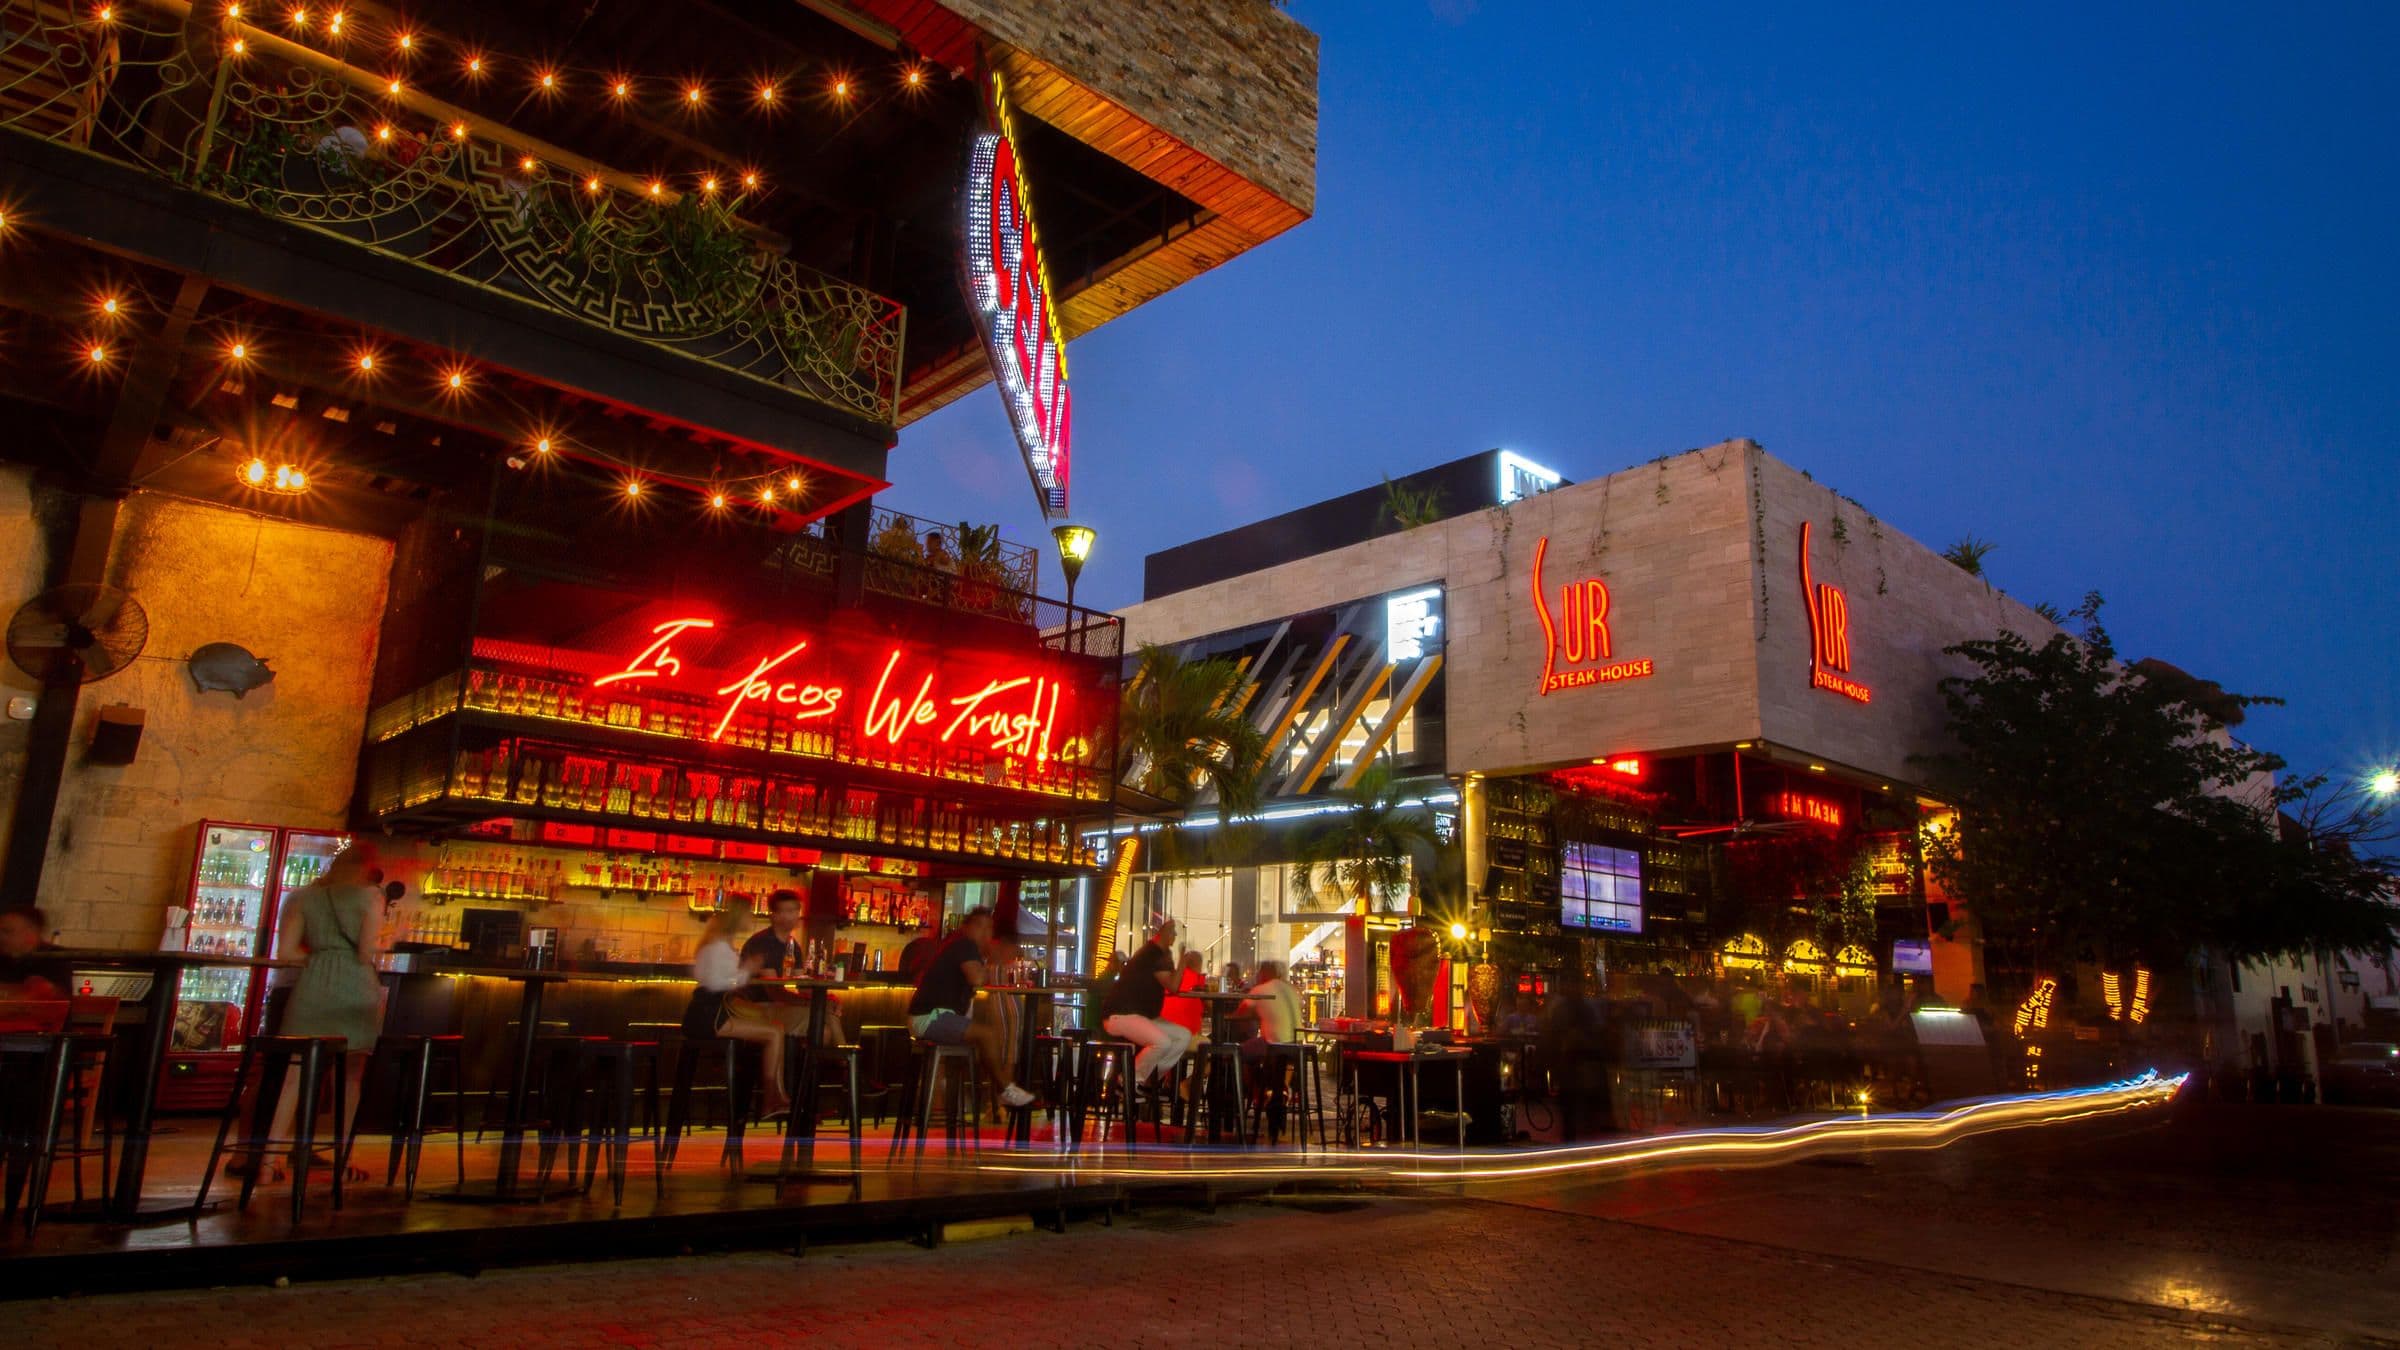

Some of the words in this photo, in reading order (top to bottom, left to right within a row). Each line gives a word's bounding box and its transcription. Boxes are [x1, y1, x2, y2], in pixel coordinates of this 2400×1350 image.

[1533, 536, 1611, 696] SUR
[1800, 521, 1850, 689] SUR
[594, 618, 716, 687] In
[715, 640, 842, 738] Tacos
[864, 650, 937, 743] We
[1549, 667, 1597, 692] STEAK
[1599, 659, 1654, 683] HOUSE
[1816, 672, 1843, 695] STEAK
[1844, 681, 1871, 705] HOUSE
